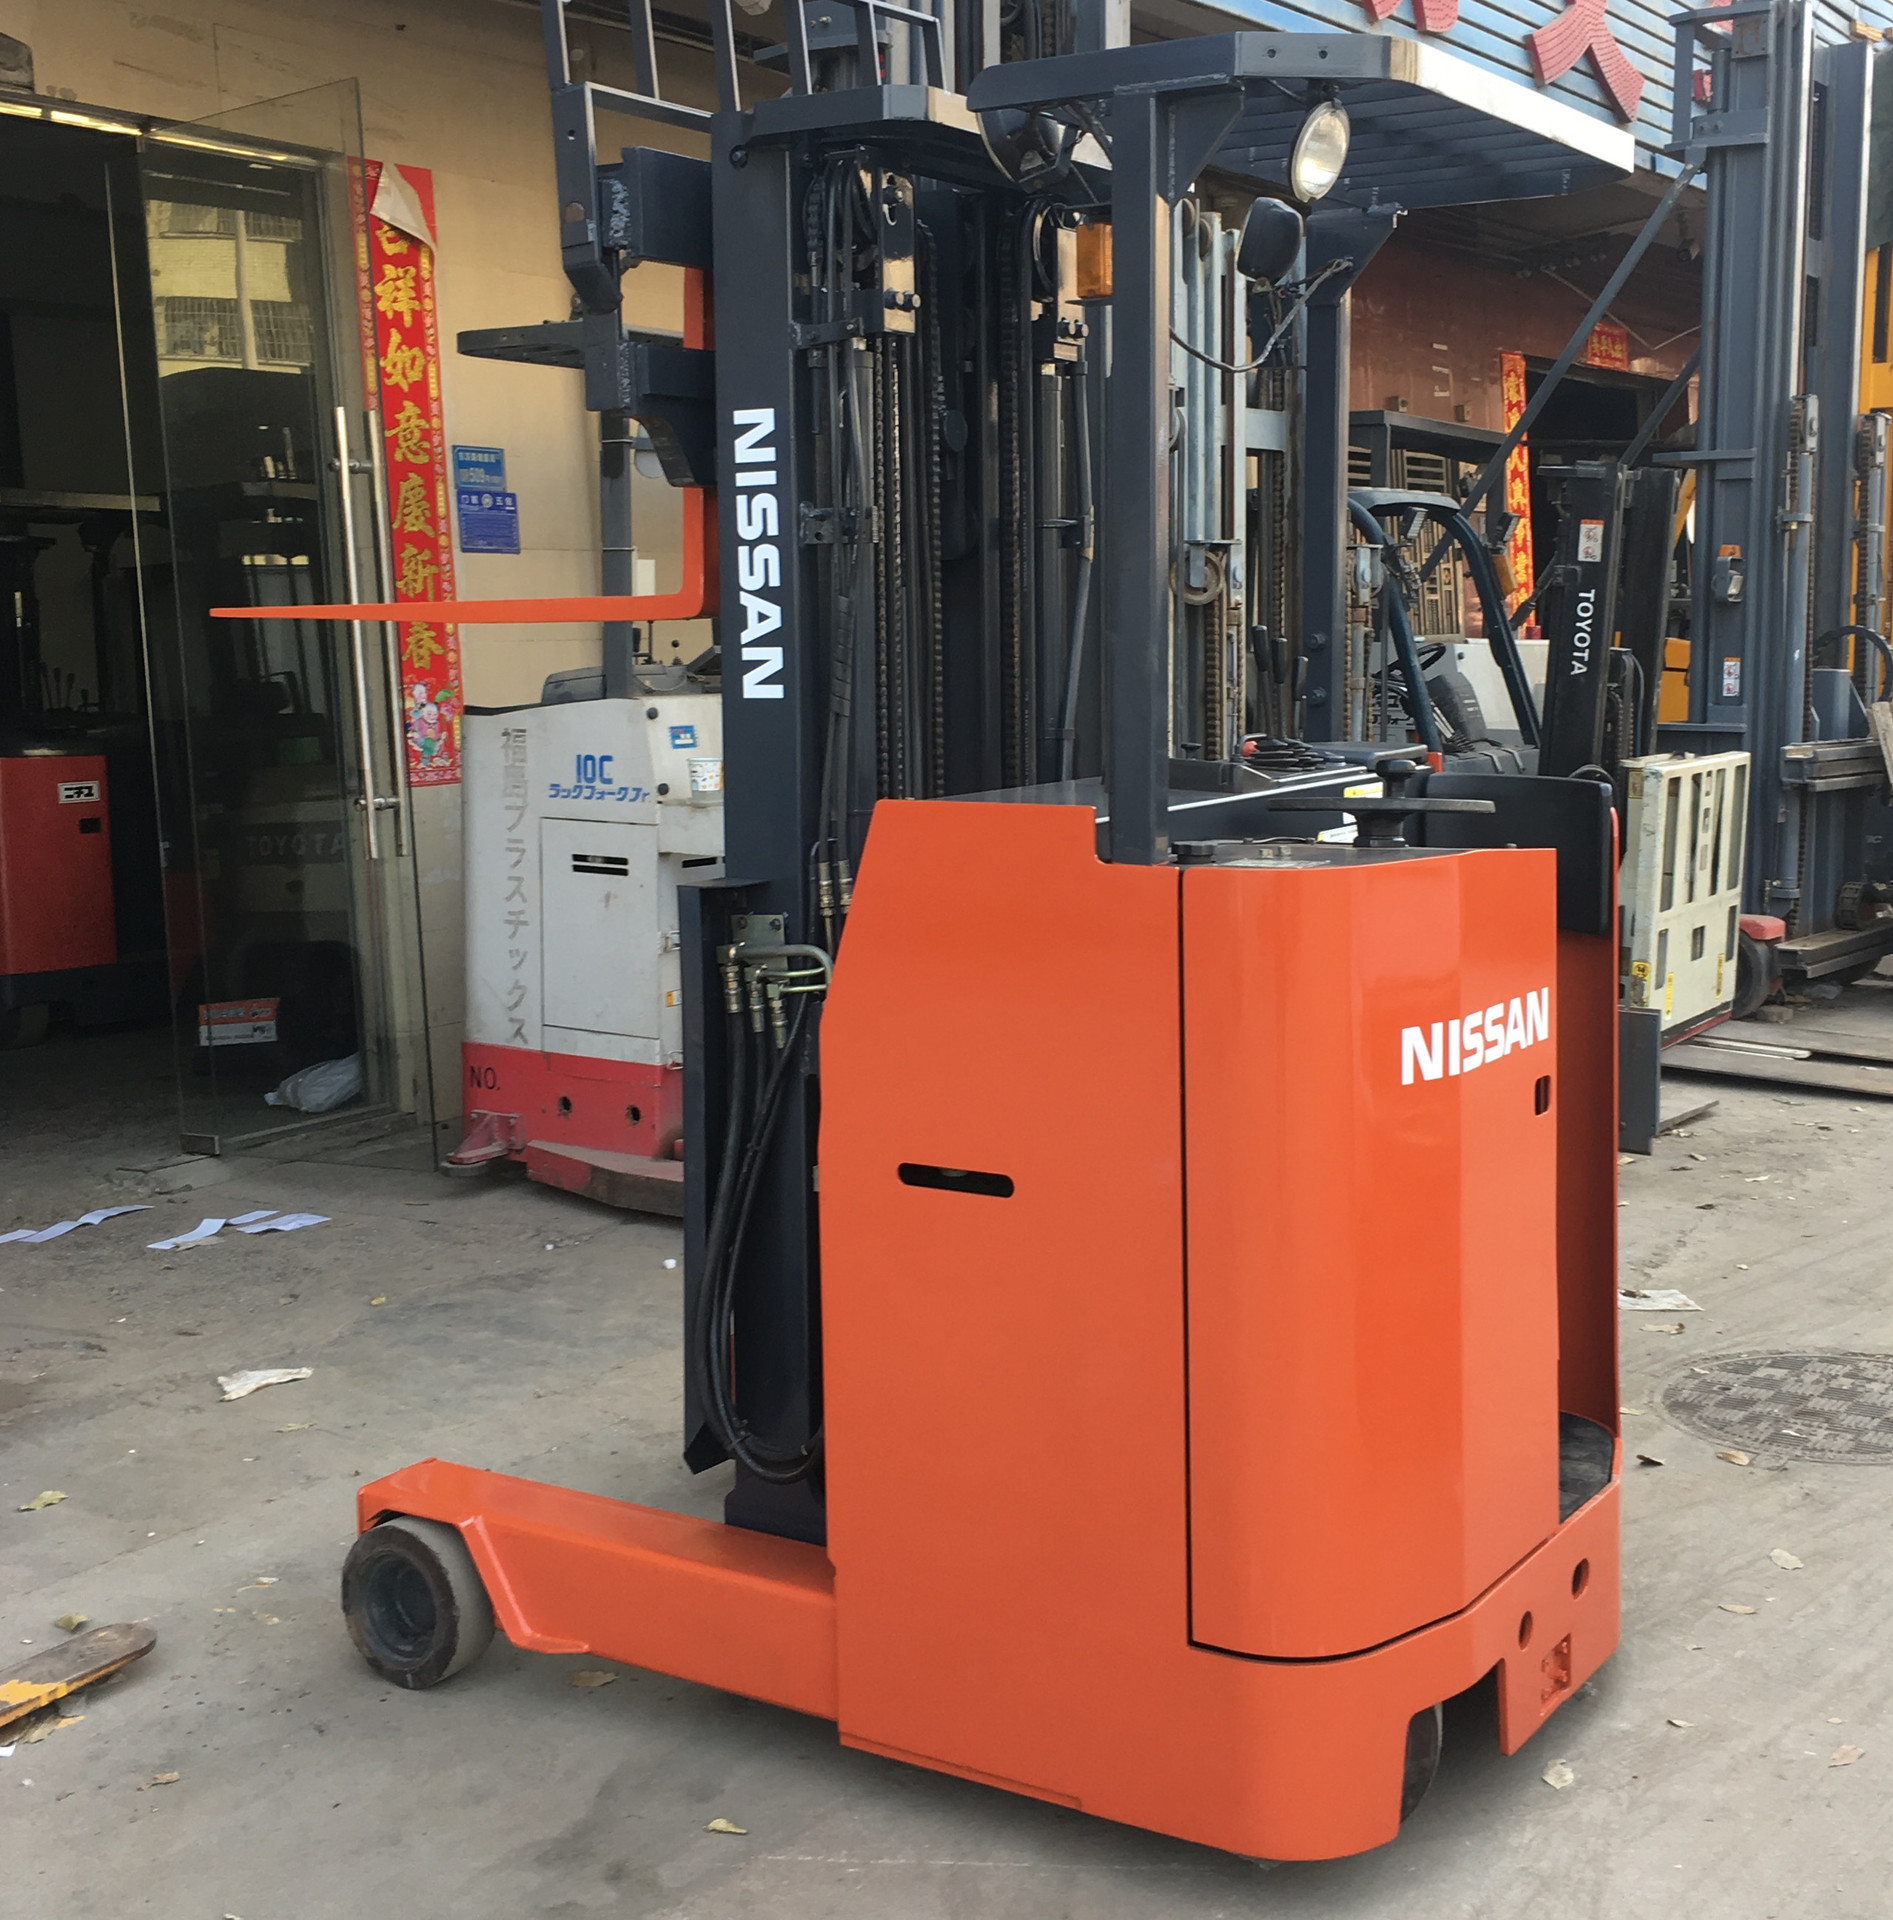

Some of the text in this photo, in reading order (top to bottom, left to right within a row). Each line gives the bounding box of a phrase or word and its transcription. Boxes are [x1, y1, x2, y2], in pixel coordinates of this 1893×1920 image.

[732, 407, 785, 700] NISSAN
[1570, 588, 1596, 676] TOYOTA
[1401, 986, 1550, 1086] NISSAN
